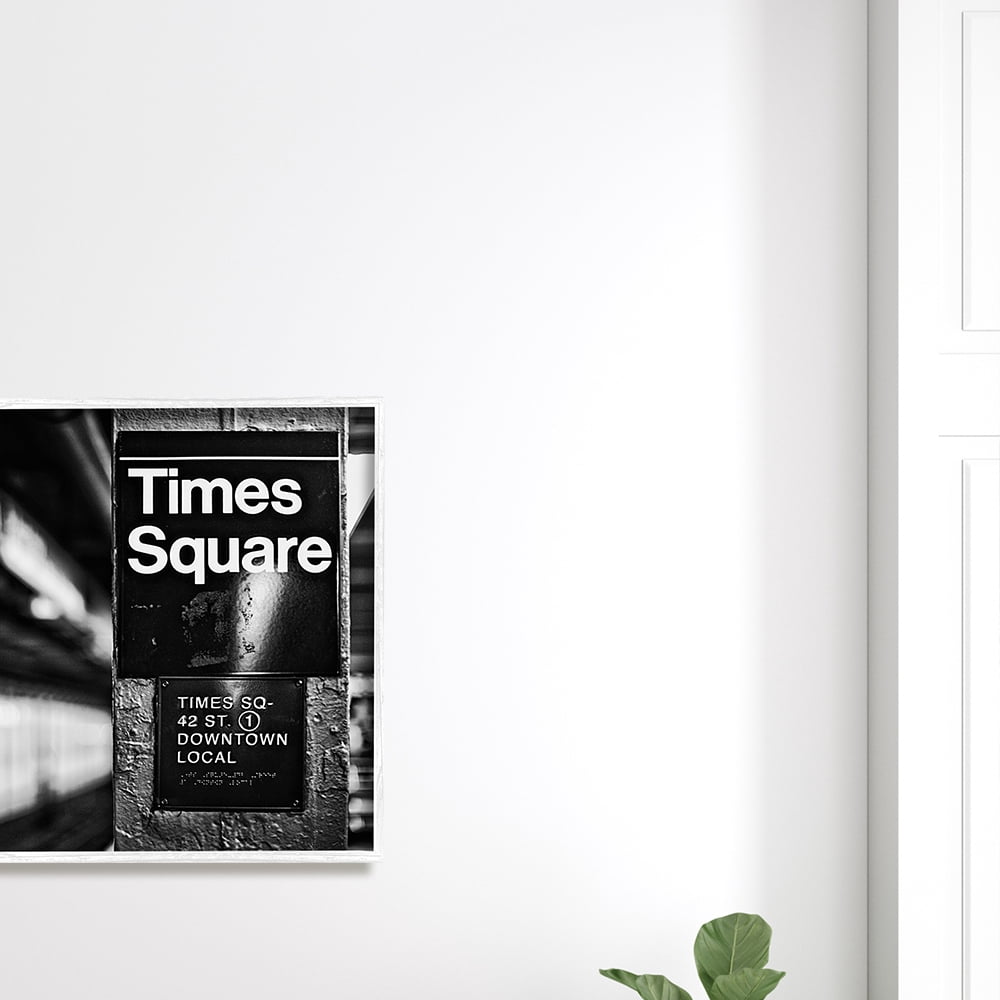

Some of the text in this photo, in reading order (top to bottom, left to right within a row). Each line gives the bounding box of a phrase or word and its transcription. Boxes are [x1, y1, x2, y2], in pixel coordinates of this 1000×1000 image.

[127, 467, 303, 515] Times
[127, 525, 333, 585] Square
[177, 696, 274, 710] TIMES SQ-
[177, 714, 198, 728] 42
[204, 714, 231, 728] ST.
[177, 732, 288, 746] DOWNTOWN
[177, 750, 237, 764] LOCAL
